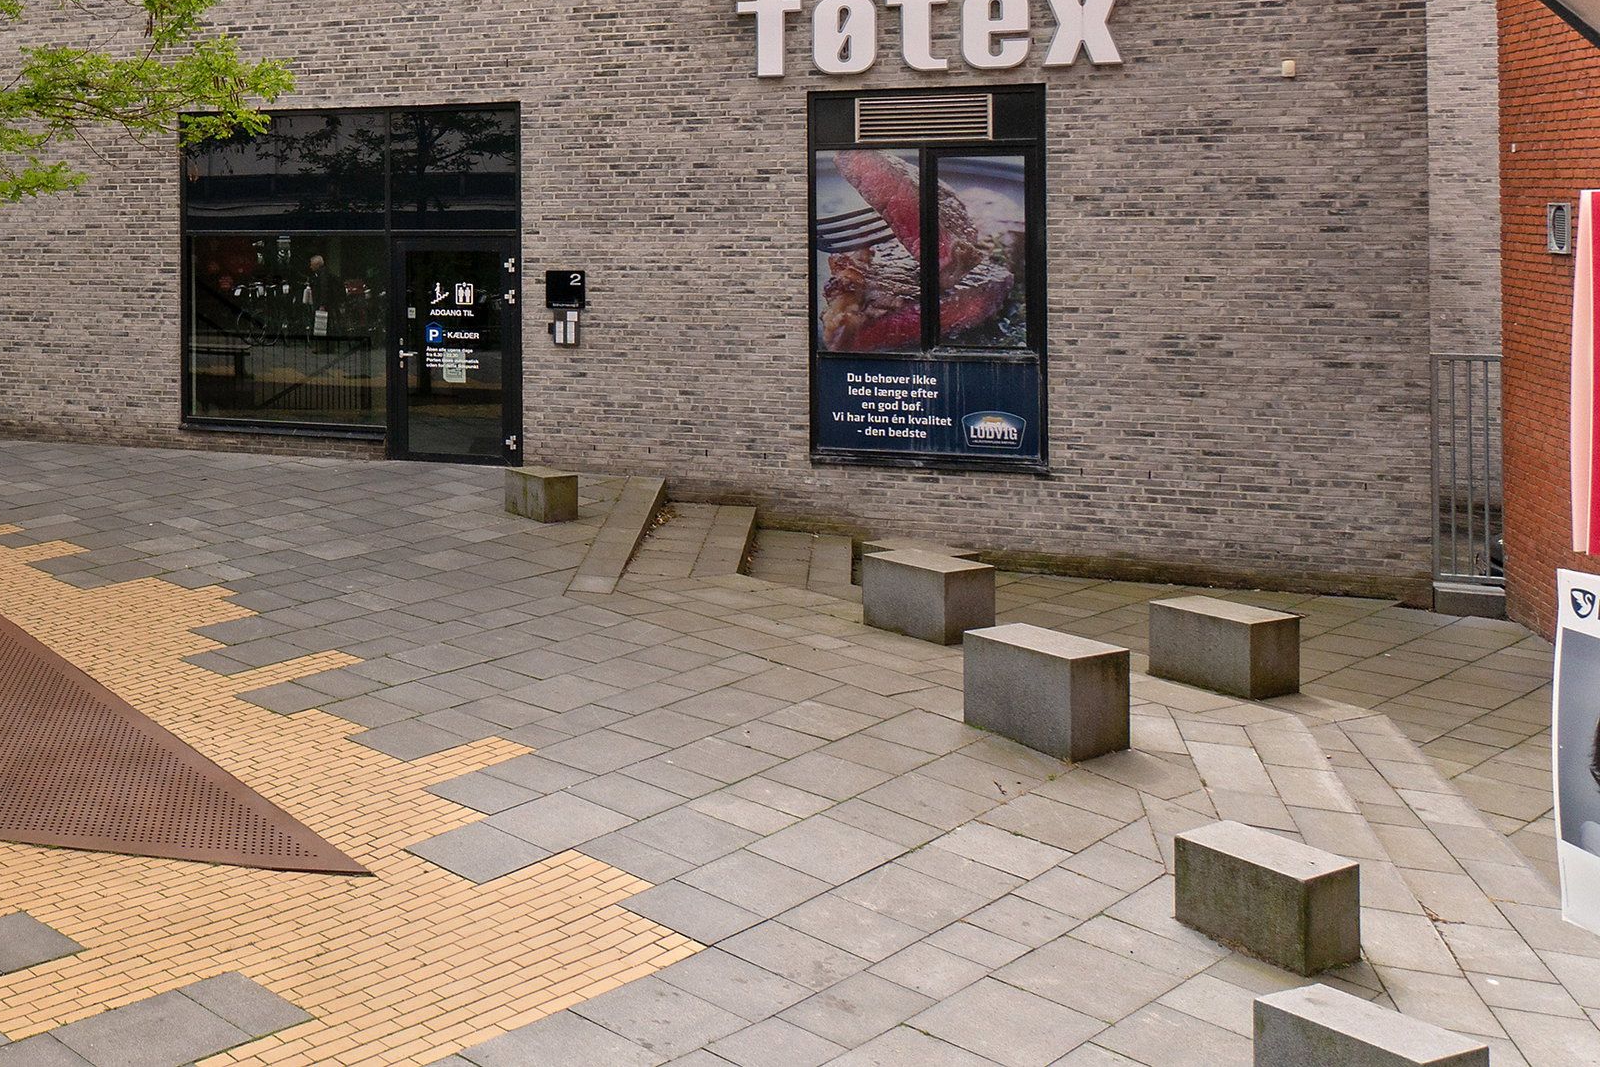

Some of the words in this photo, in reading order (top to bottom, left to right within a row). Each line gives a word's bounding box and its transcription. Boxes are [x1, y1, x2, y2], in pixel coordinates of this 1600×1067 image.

[569, 273, 582, 286] 2
[429, 309, 463, 317] ADGANG
[463, 309, 475, 317] TIL
[429, 329, 440, 341] P
[846, 372, 862, 383] Du
[864, 372, 910, 384] behøver
[912, 374, 937, 385] ikke
[848, 386, 872, 396] lede
[874, 387, 908, 400] længe
[910, 388, 938, 399] efter
[861, 401, 875, 410] en
[878, 401, 899, 412] god
[902, 401, 924, 412] bøf.
[832, 412, 844, 422] Vi
[847, 412, 866, 423] har
[868, 413, 889, 423] kun
[891, 414, 905, 424] én
[908, 414, 952, 426] kvalitet
[865, 426, 886, 437] den
[888, 427, 927, 439] bedste
[970, 425, 1018, 441] LUDVIG
